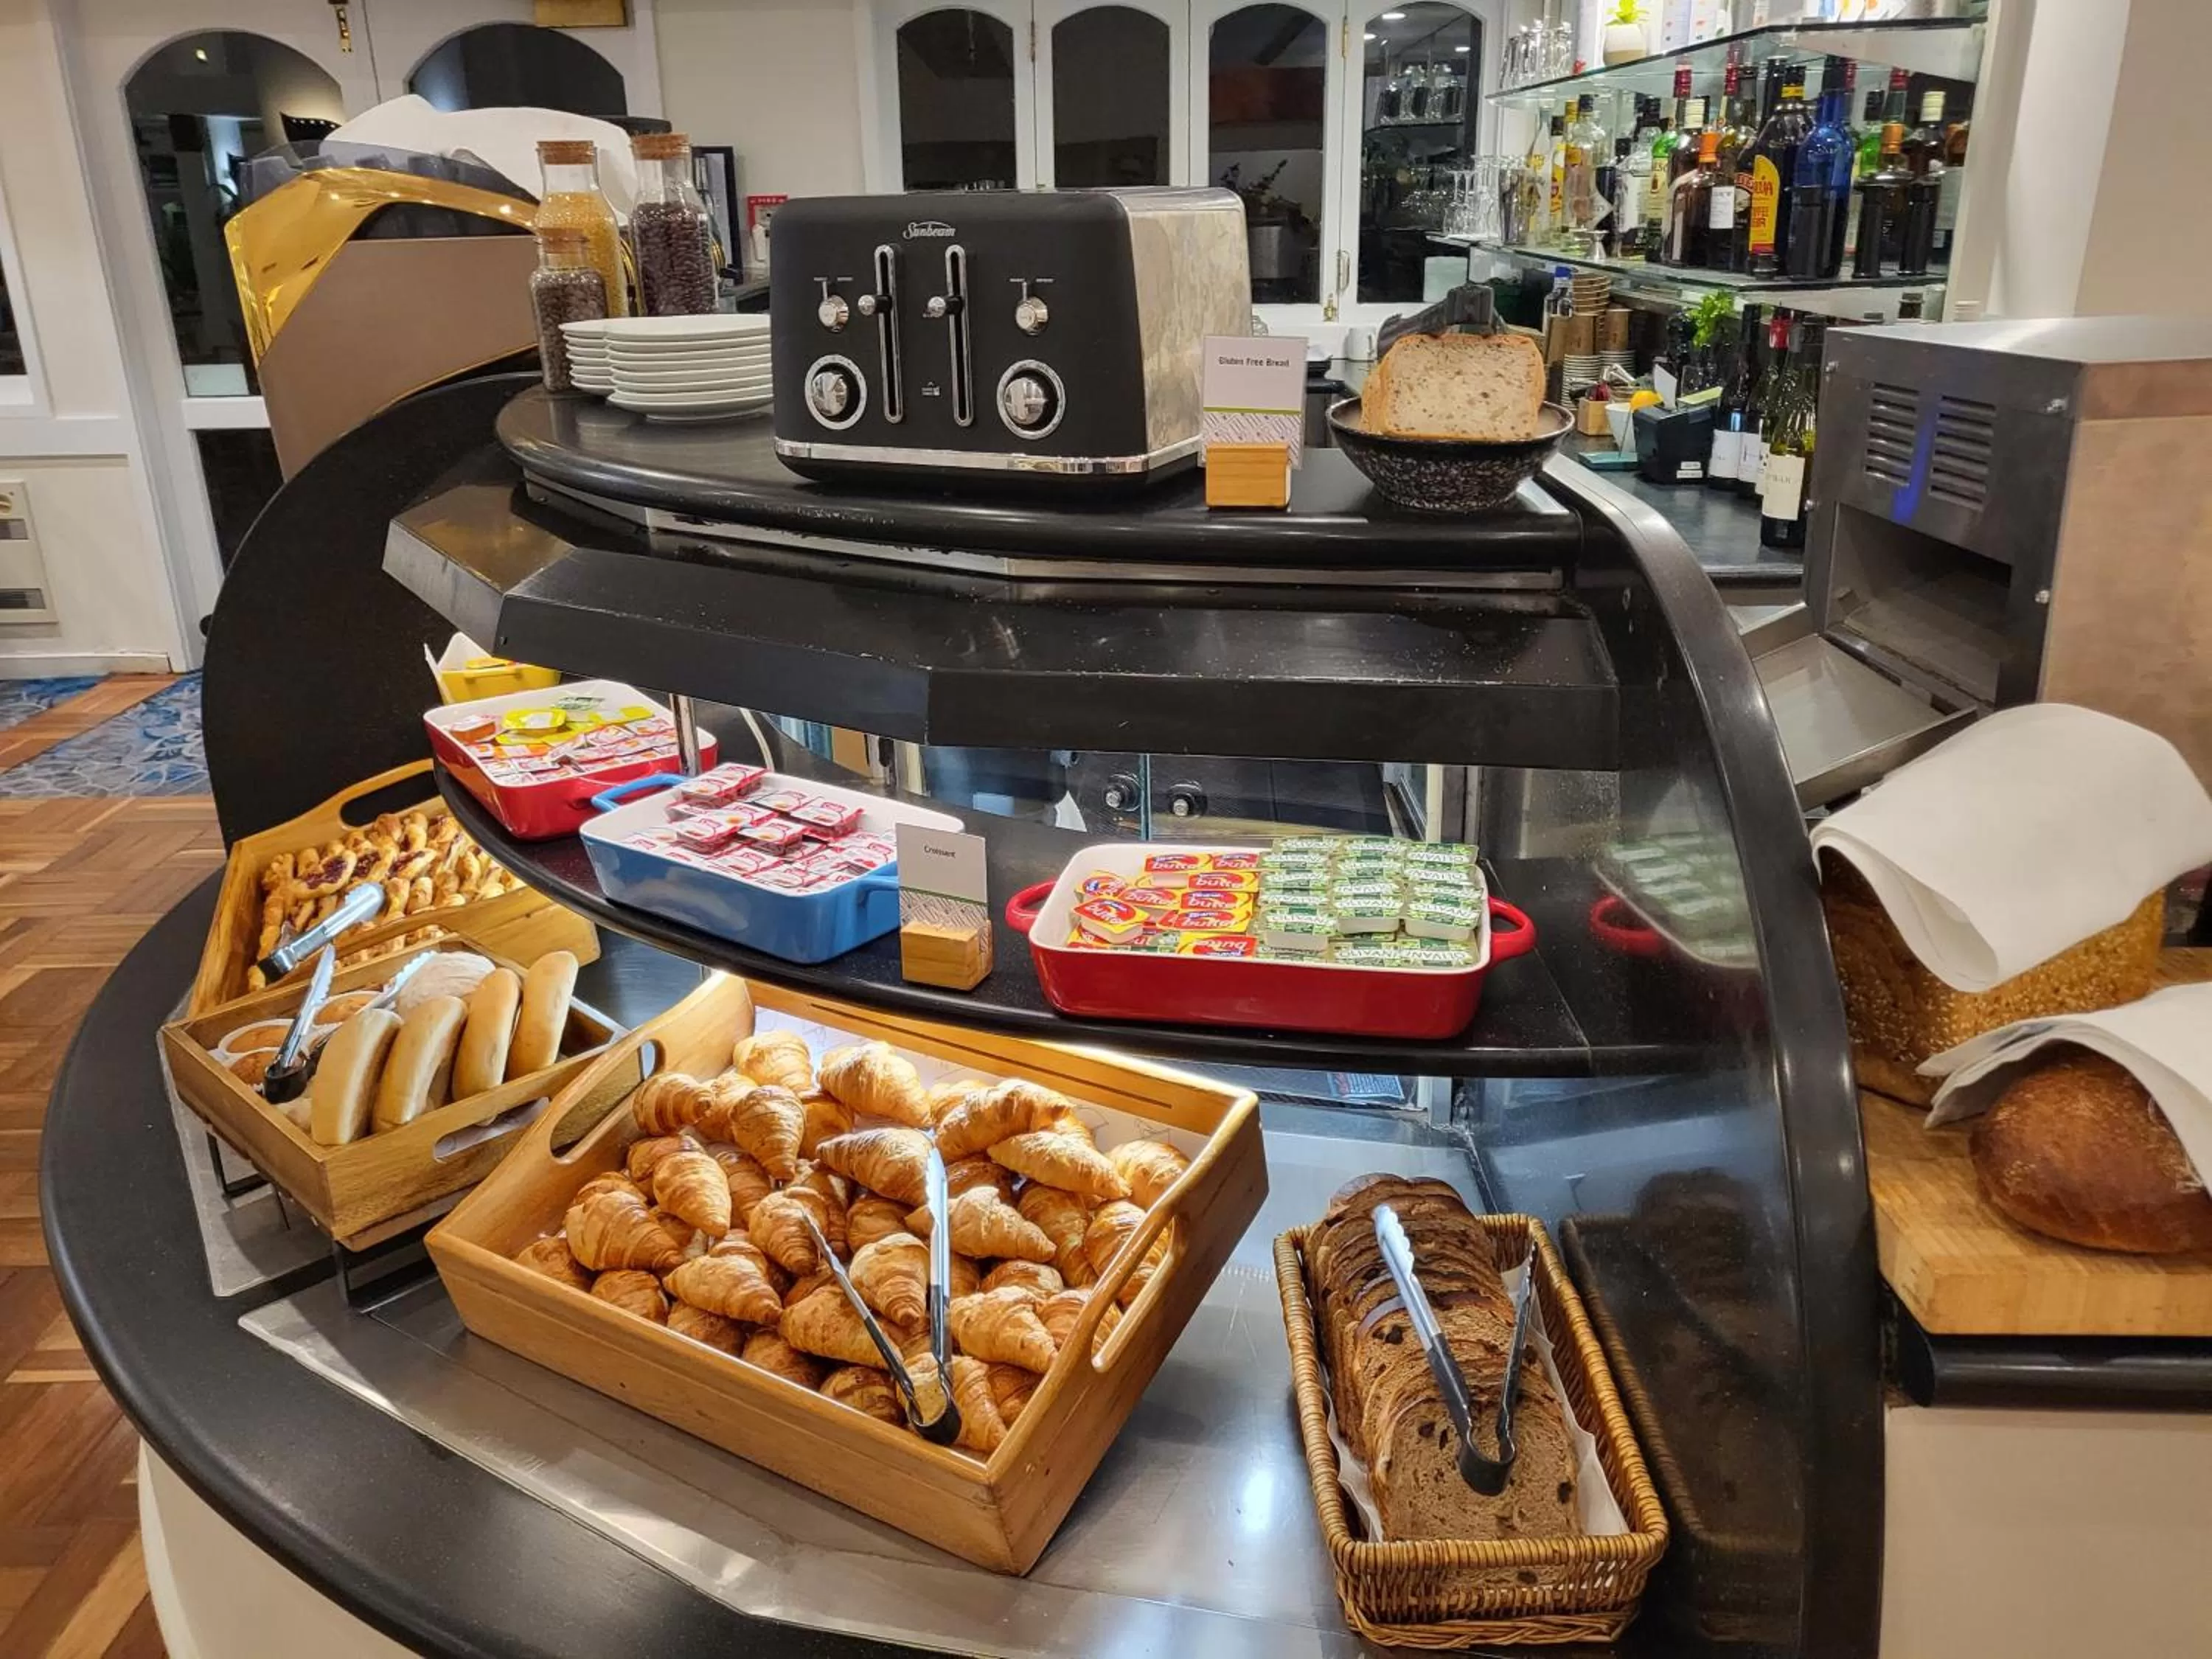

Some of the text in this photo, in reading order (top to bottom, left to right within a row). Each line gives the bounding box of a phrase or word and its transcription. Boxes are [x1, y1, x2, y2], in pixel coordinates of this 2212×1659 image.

[902, 221, 956, 240] Sunbeam
[1246, 358, 1264, 366] Free
[1266, 358, 1290, 368] Bread
